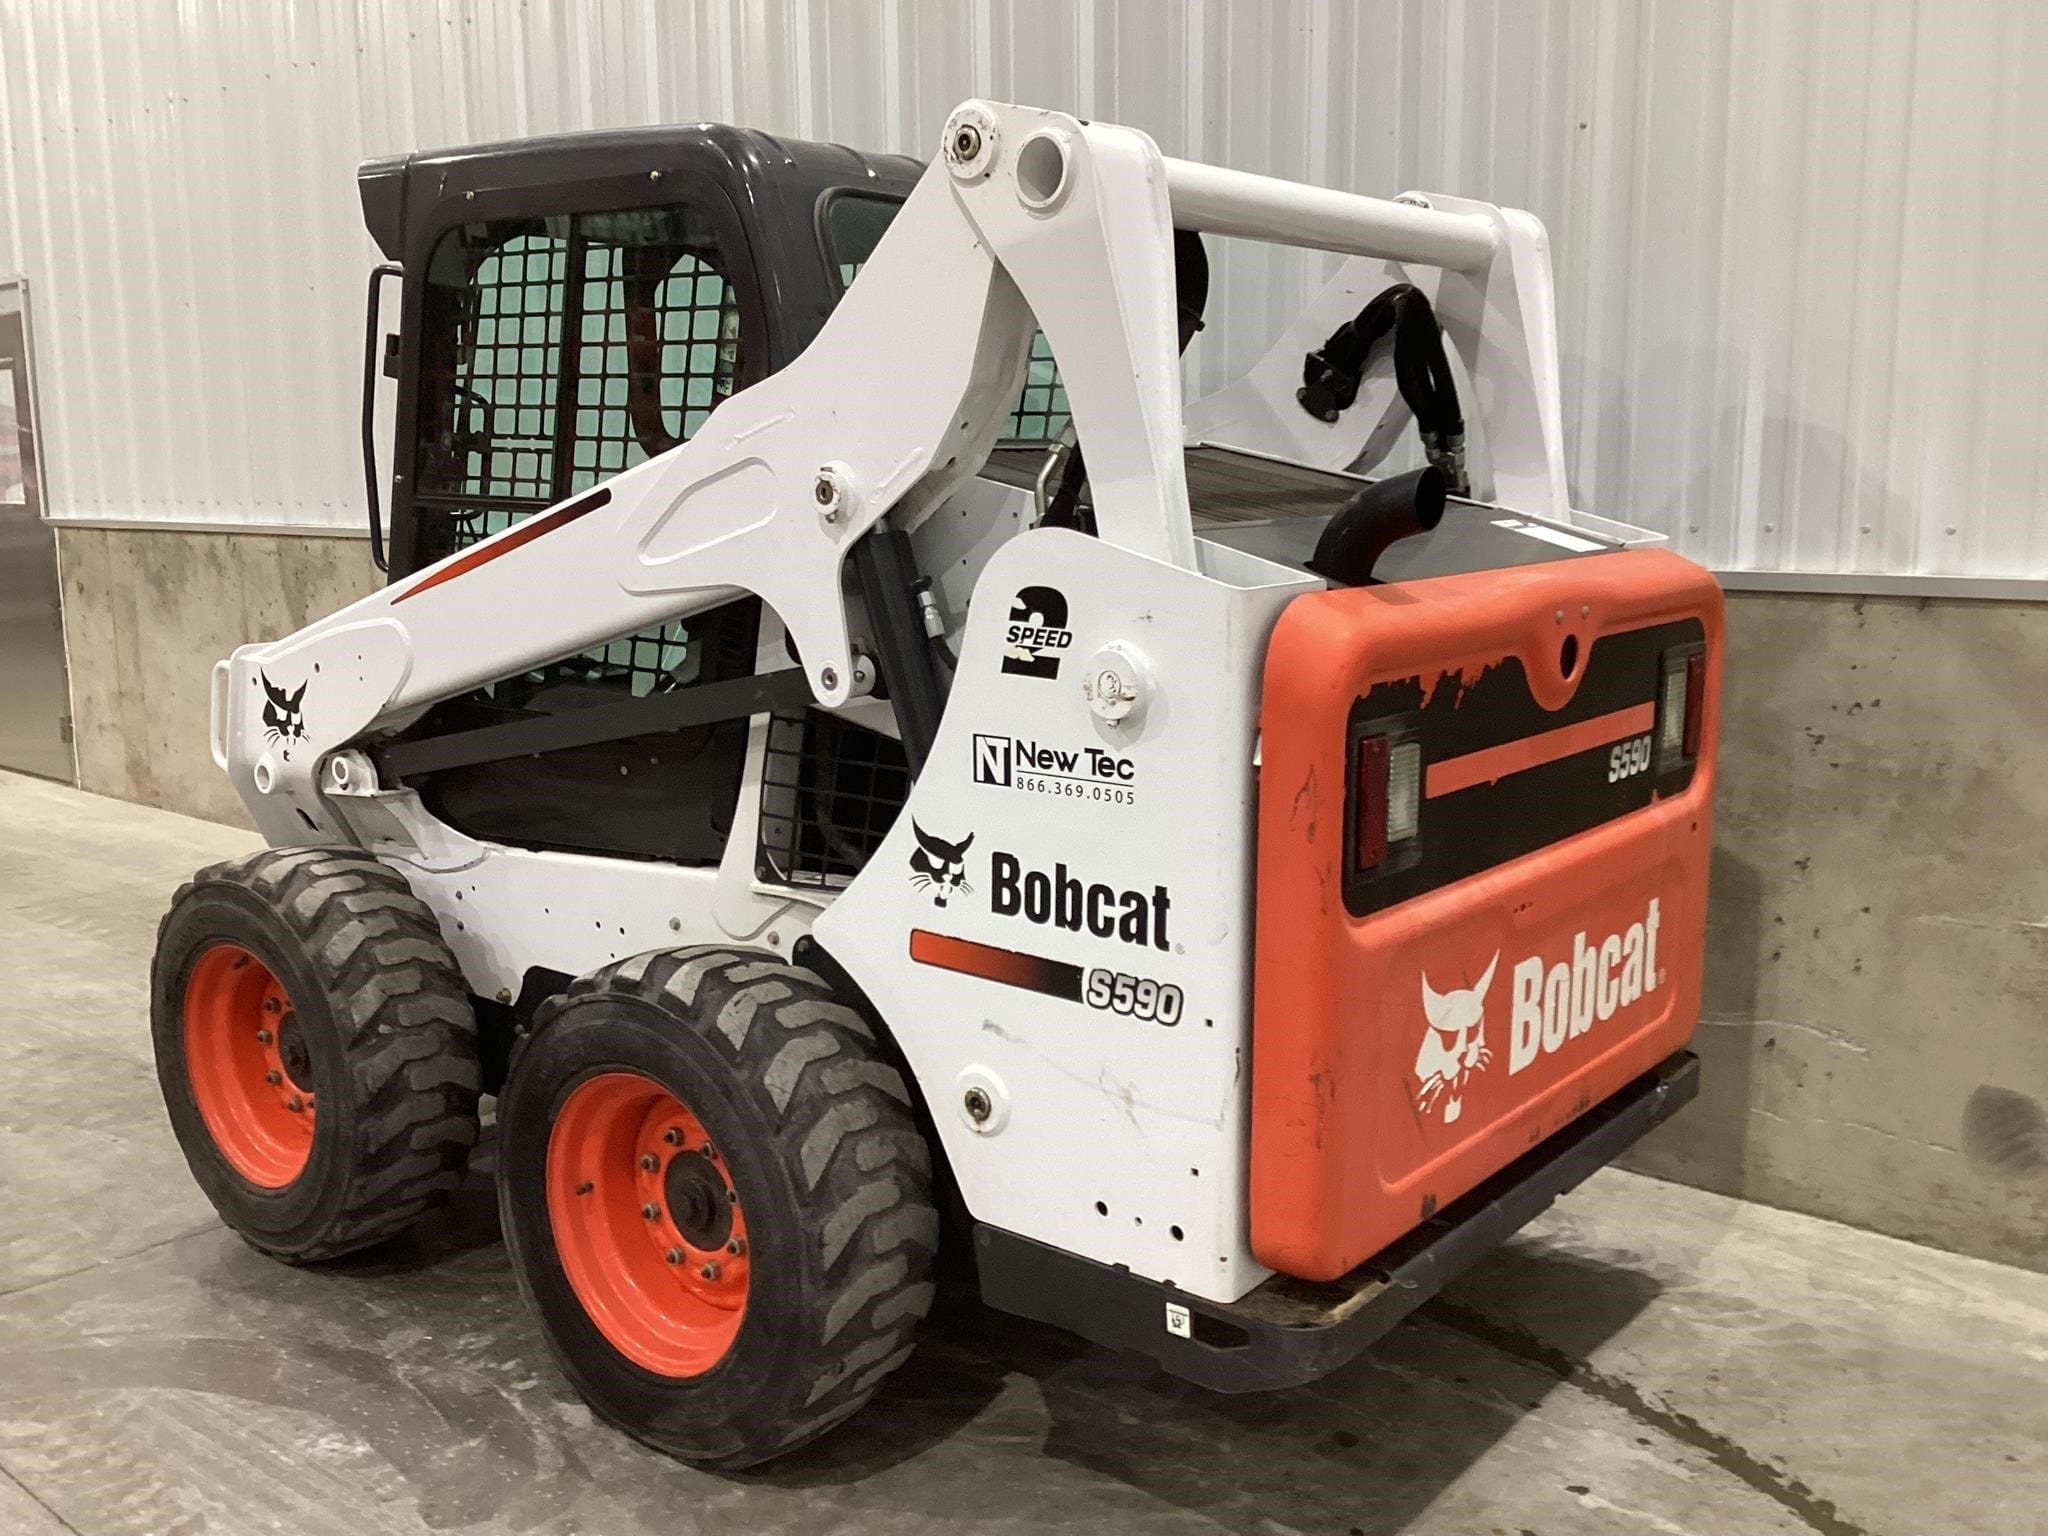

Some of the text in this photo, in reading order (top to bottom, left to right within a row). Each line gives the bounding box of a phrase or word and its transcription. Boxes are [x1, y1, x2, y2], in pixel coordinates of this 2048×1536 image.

[1006, 625, 1073, 648] SPEED
[1016, 739, 1135, 780] New Tec
[1608, 735, 1652, 784] S590
[1016, 777, 1135, 805] 866.369.0505
[991, 851, 1171, 951] Bobcat
[1086, 967, 1185, 1028] S590
[1509, 897, 1660, 1076] Bobcat
